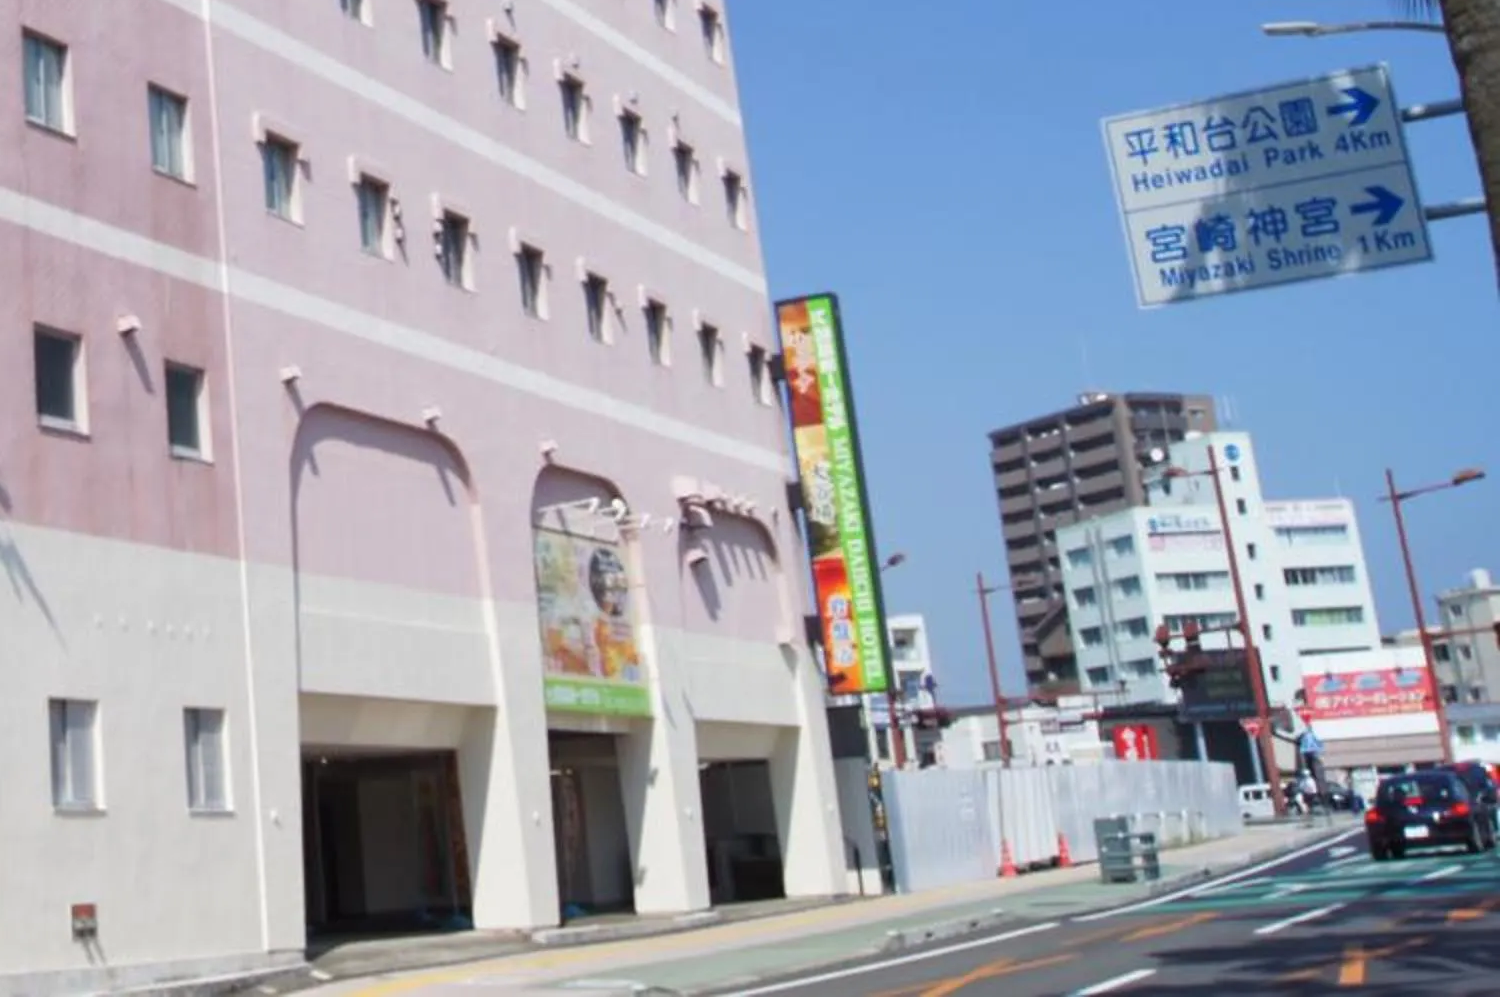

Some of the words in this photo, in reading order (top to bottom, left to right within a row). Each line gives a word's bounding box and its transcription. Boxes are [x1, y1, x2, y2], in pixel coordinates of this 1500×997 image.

[1124, 96, 1318, 166] 平和台公園
[1131, 157, 1249, 193] Heiwadai
[1265, 141, 1325, 169] Park
[1334, 125, 1392, 154] 4Km
[1145, 195, 1341, 265] 宮崎神宮
[1159, 255, 1256, 289] Miyazaki
[1266, 241, 1343, 271] Shrine
